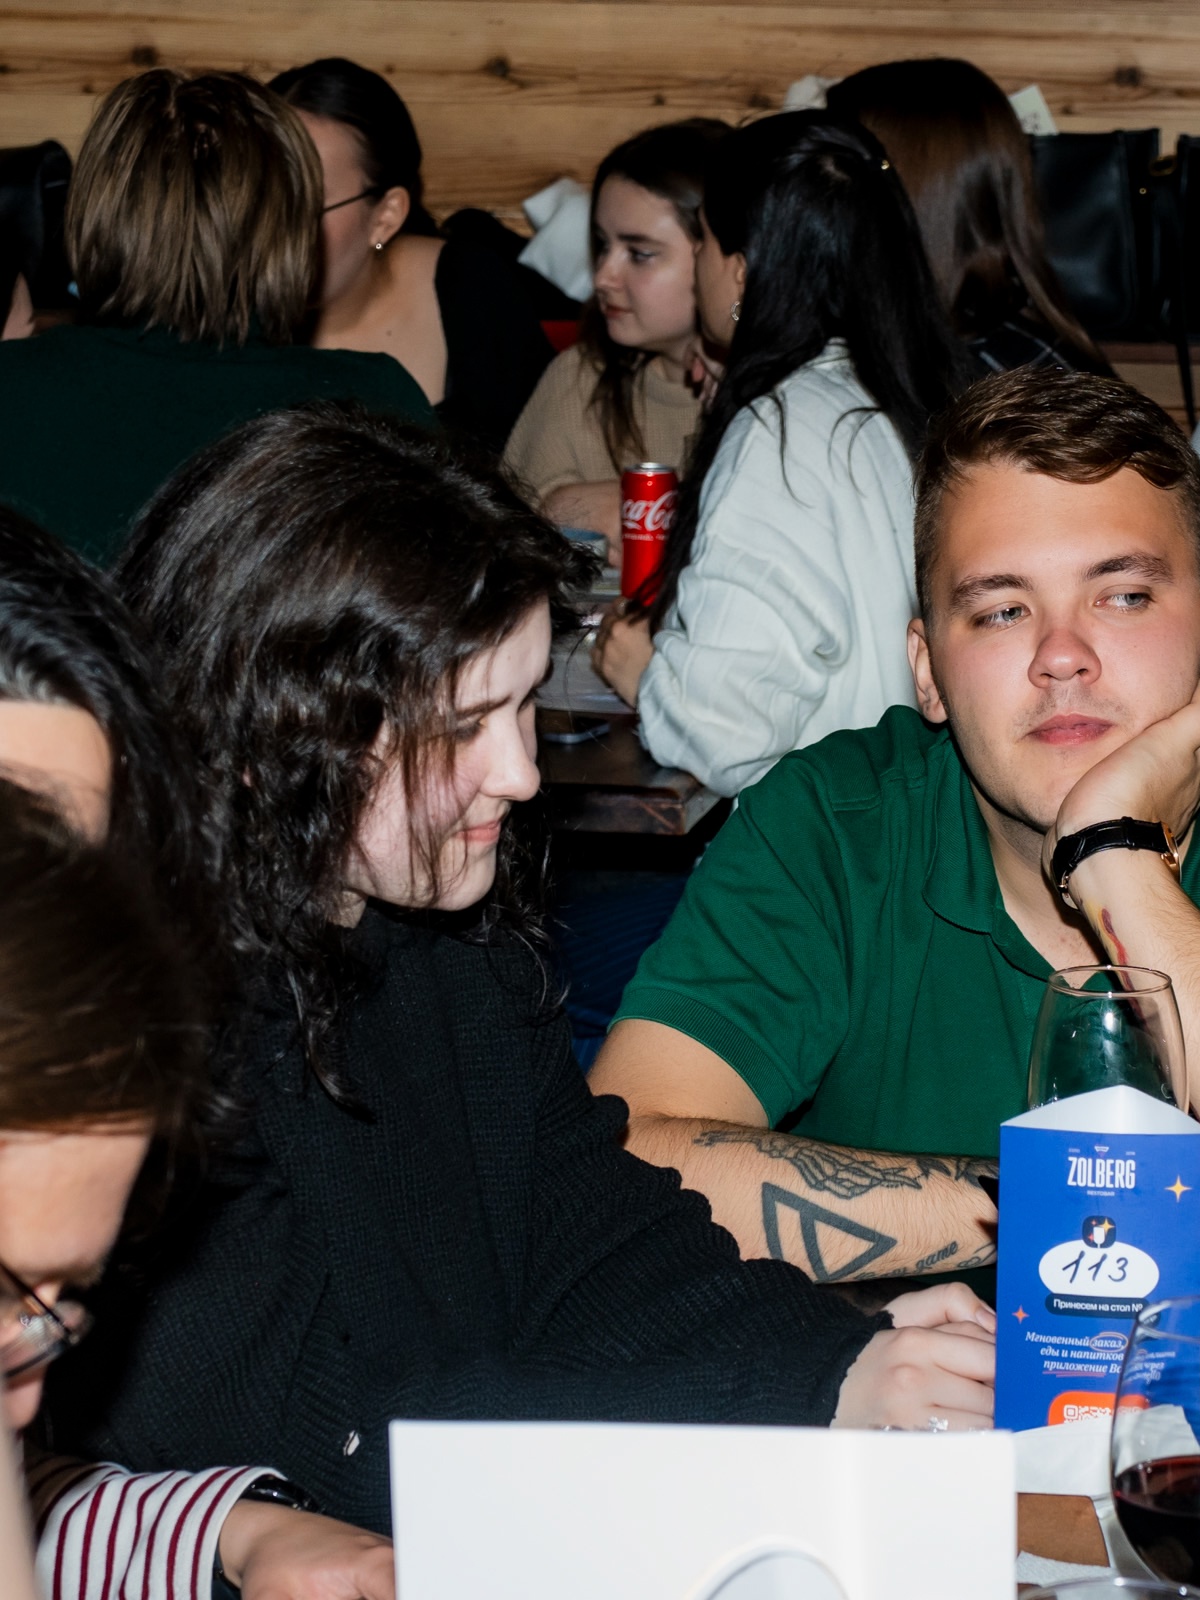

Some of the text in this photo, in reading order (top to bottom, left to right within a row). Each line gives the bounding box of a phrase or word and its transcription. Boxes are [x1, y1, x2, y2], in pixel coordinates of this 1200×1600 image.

[1067, 1156, 1136, 1190] ZOLBERG
[1062, 1250, 1129, 1284] 113
[1053, 1298, 1098, 1311] Принесем
[1098, 1302, 1110, 1312] на
[1110, 1303, 1131, 1313] стол
[1025, 1331, 1090, 1347] Мгновенный
[1040, 1345, 1060, 1357] еды
[1061, 1349, 1069, 1358] и
[1069, 1349, 1125, 1362] напитков
[1043, 1360, 1109, 1373] приложение
